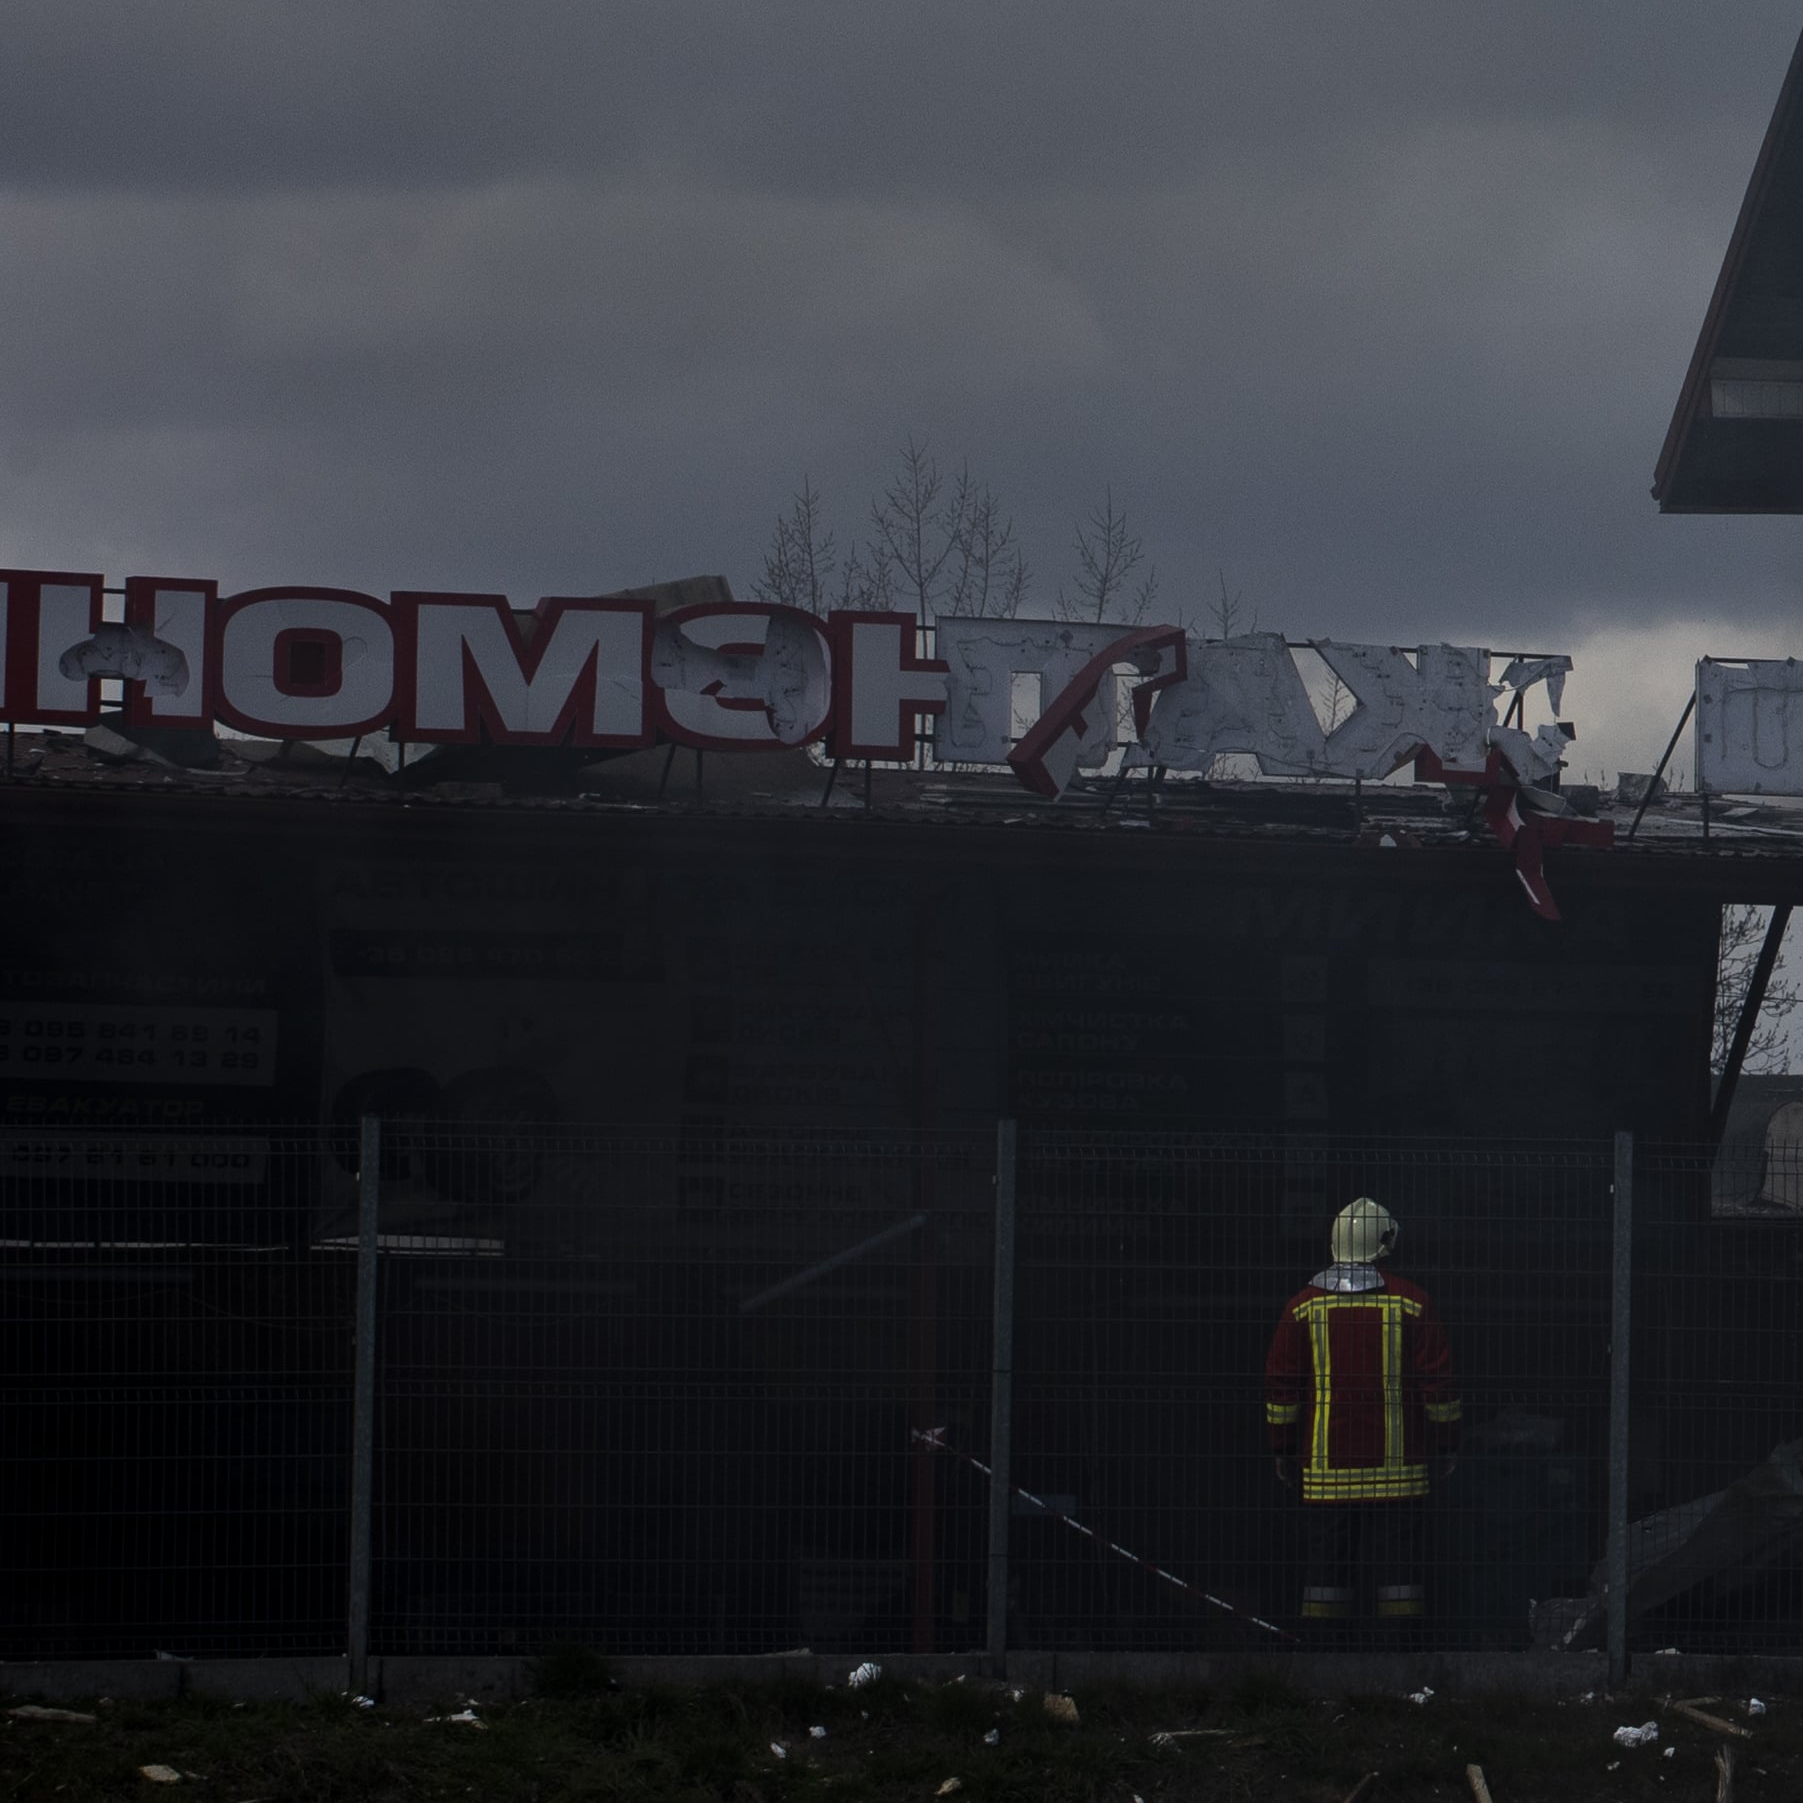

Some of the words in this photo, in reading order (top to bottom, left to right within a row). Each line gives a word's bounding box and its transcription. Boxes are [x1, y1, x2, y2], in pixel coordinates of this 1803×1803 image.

[1014, 950, 1126, 968] МИЙКА
[1016, 1010, 1191, 1030] ХІМЧИСТКА
[24, 1020, 85, 1039] 095
[225, 1027, 260, 1044] 14
[170, 1050, 208, 1068] 13
[221, 1052, 258, 1069] 29
[5, 1094, 205, 1118] ЕВАКУАТОР
[1018, 1093, 1141, 1110] КУЗОВА
